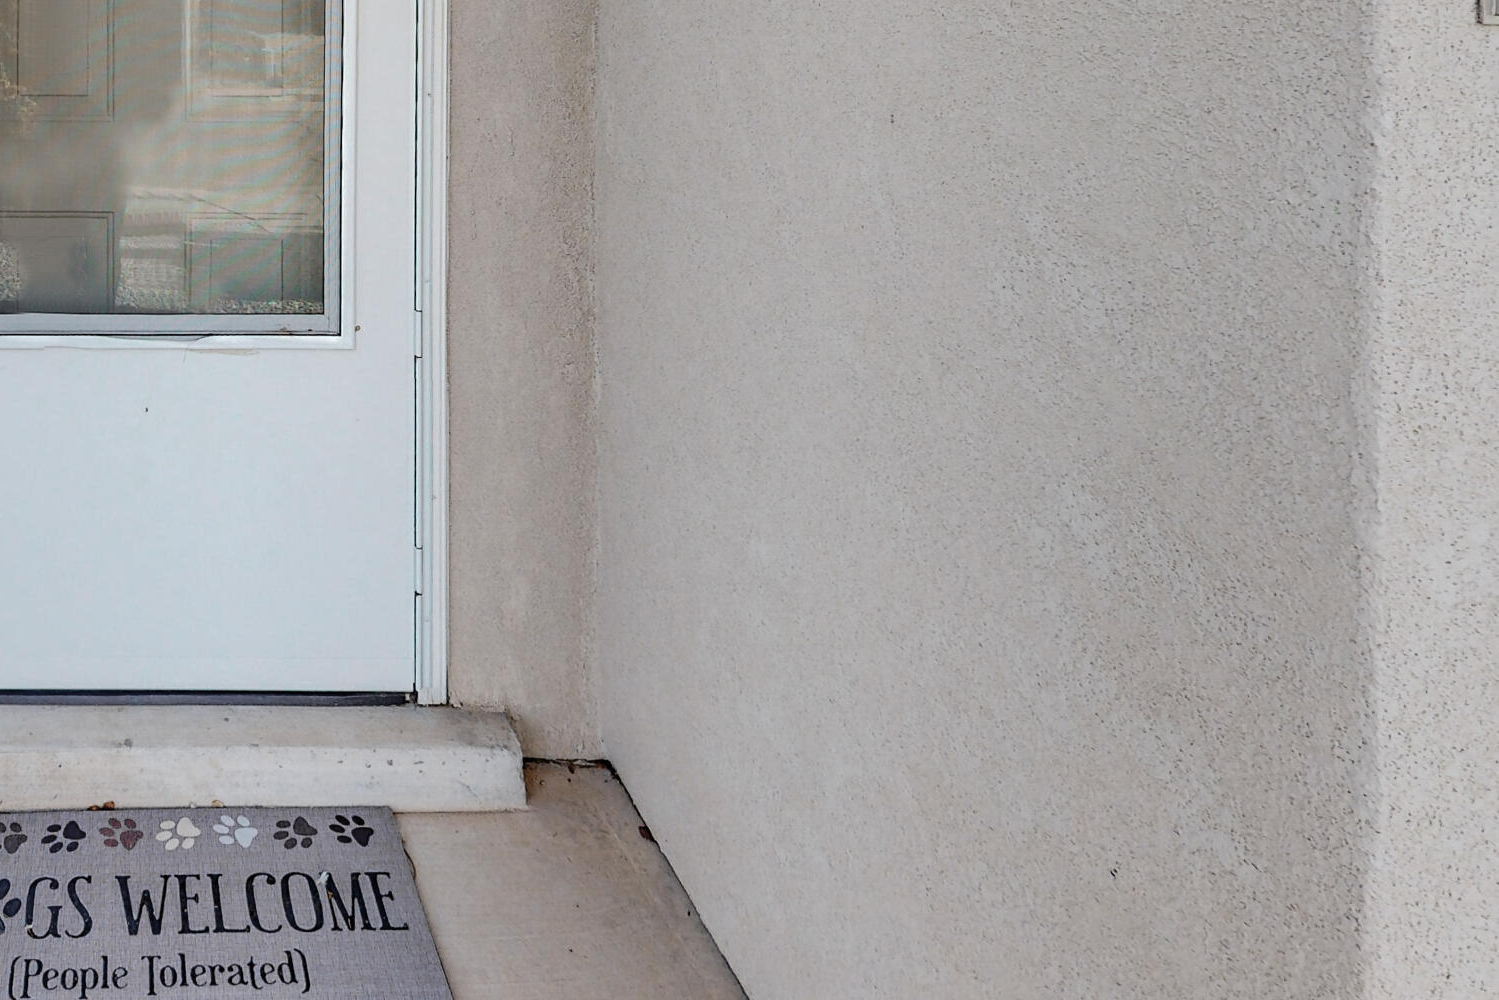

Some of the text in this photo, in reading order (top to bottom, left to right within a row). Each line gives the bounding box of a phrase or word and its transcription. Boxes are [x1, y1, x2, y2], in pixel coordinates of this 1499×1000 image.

[115, 871, 410, 936] WELCOME
[7, 948, 312, 1000] (People Tolerated)
